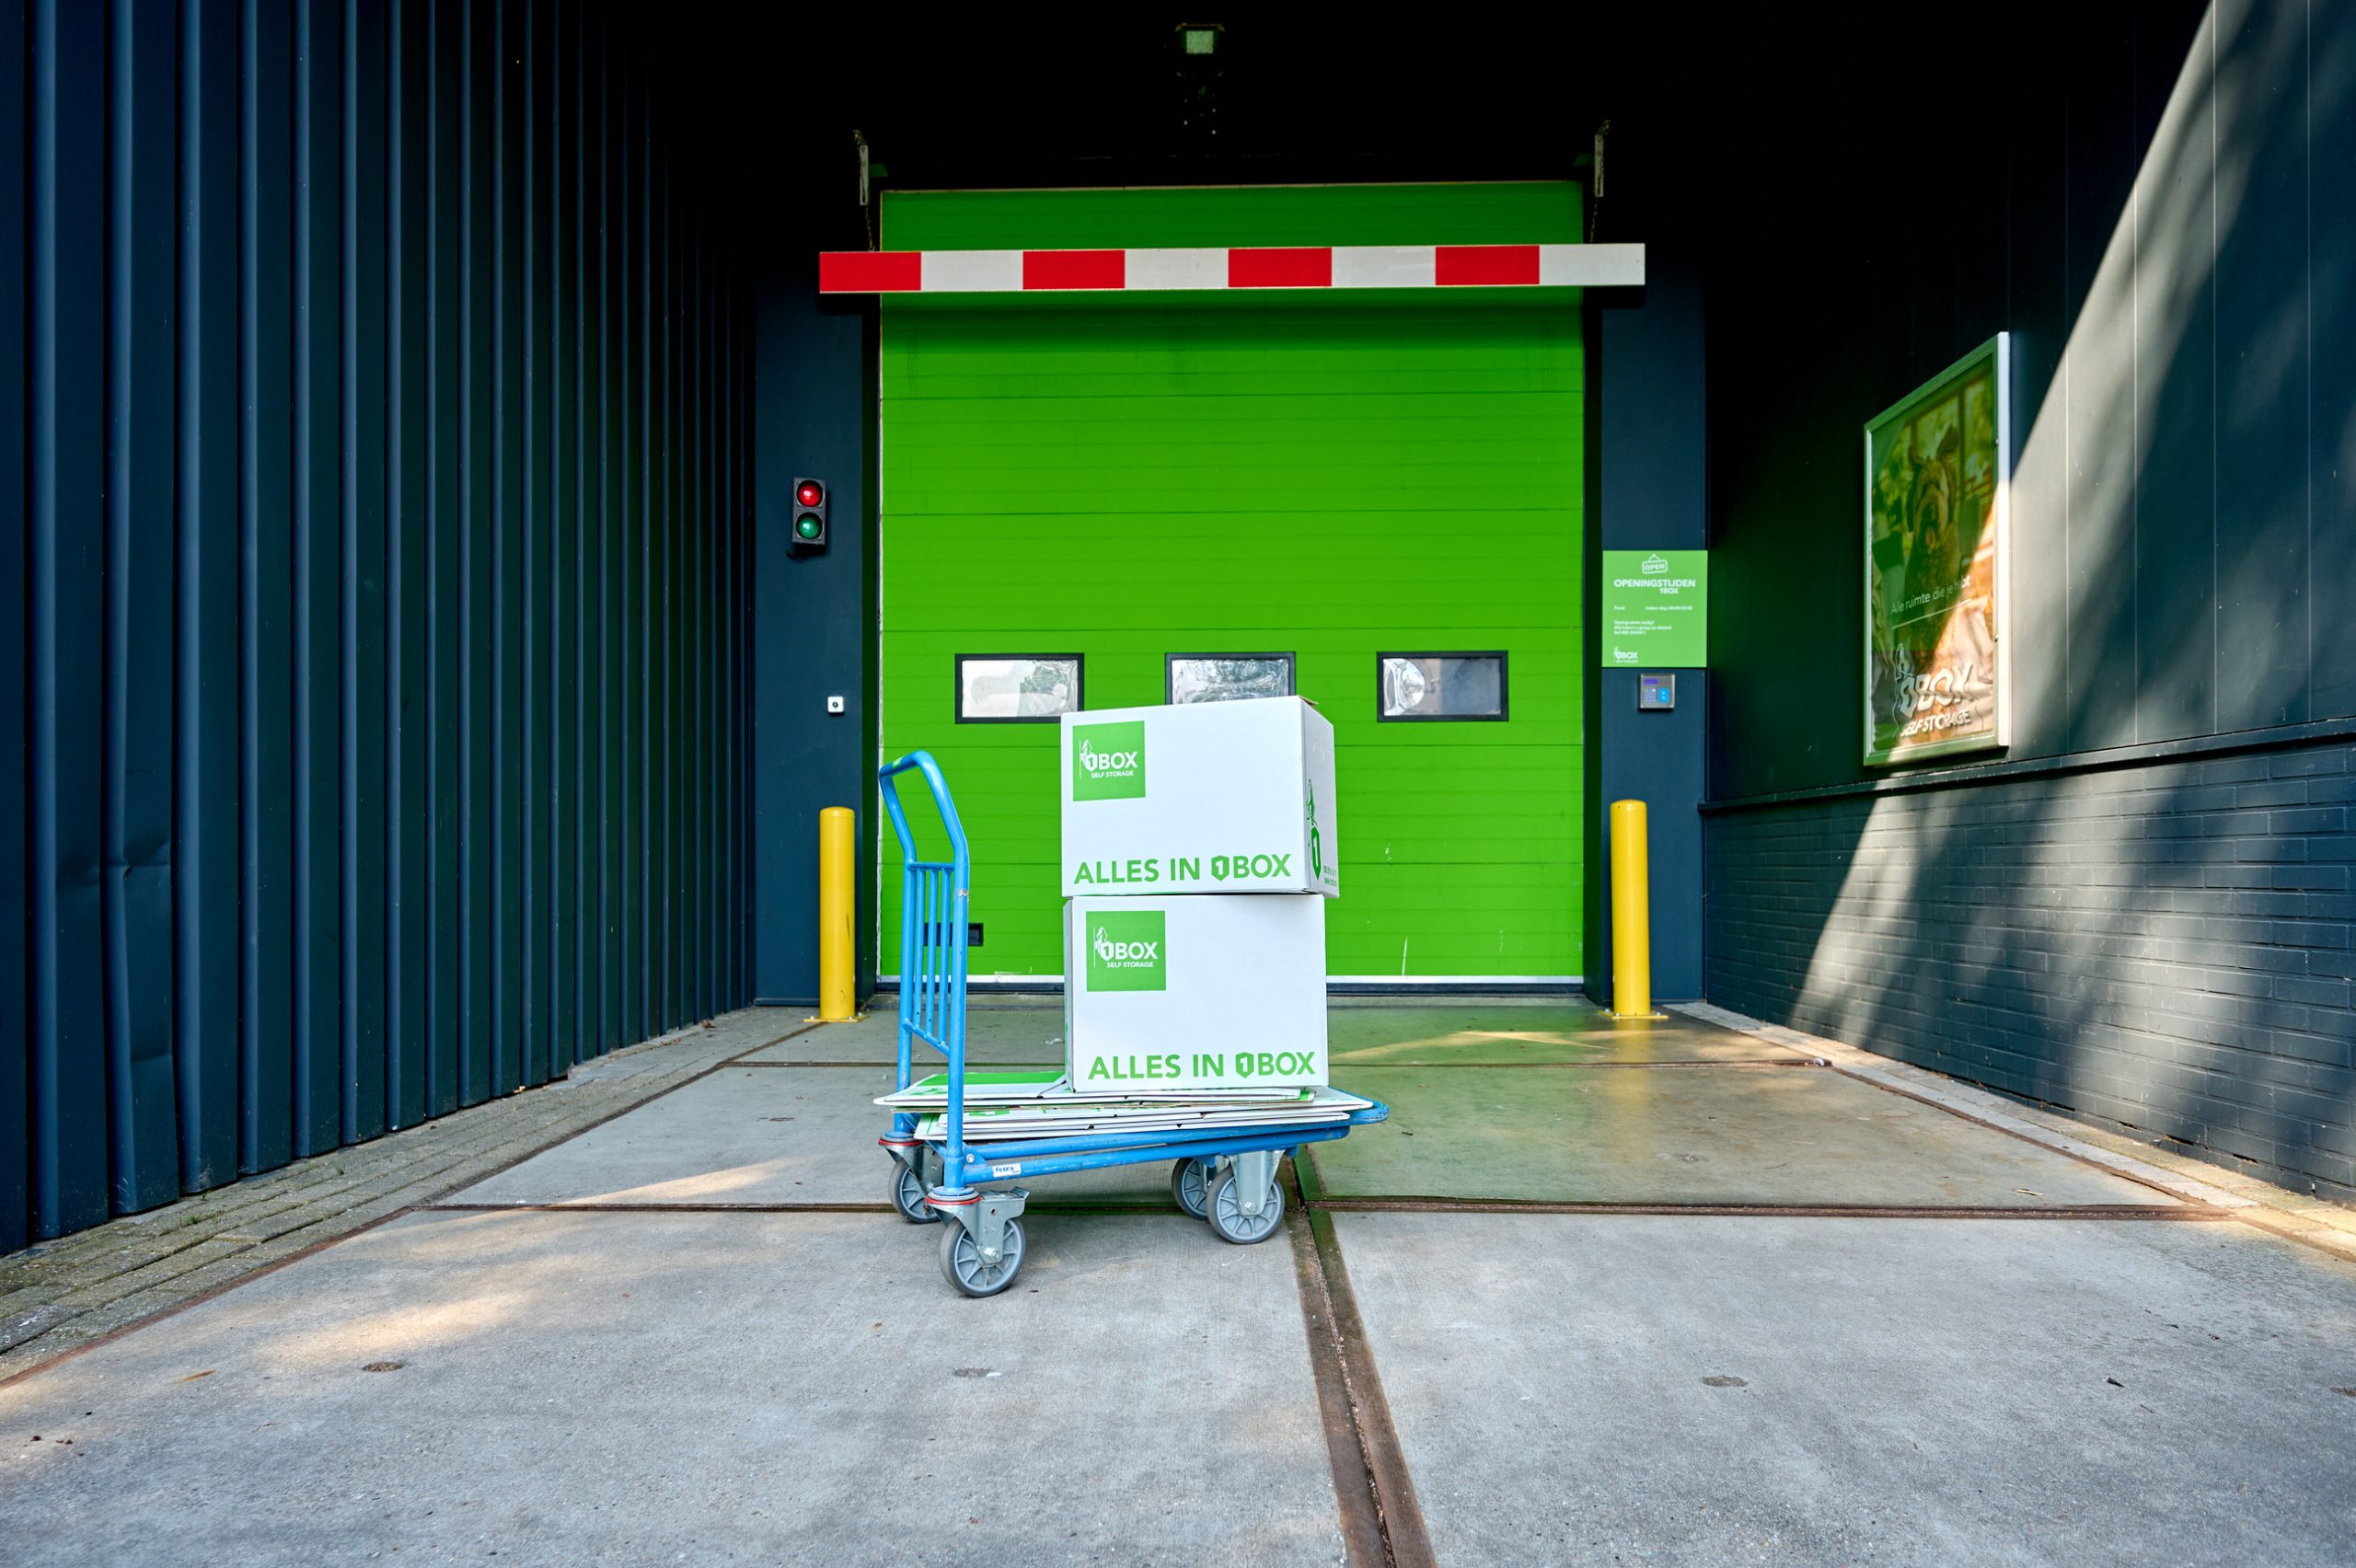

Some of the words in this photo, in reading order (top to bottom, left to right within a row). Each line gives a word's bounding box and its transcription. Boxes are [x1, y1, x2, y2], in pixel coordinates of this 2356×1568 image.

[1613, 579, 1695, 587] OPENINGSTIJDEN
[1891, 599, 1904, 615] Alle
[1906, 594, 1931, 610] ruimte
[1933, 586, 1946, 600] die
[1946, 582, 1953, 599] je
[1923, 709, 1971, 732] STORAGE
[1085, 751, 1138, 773] 1BOX
[1105, 769, 1135, 778] STORAGE
[1073, 859, 1160, 884] ALLES
[1170, 858, 1200, 881] IN
[1210, 853, 1292, 882] 1BOX
[1100, 941, 1158, 962] 1BOX
[1088, 1055, 1182, 1080] ALLES
[1193, 1054, 1224, 1078] IN
[1235, 1051, 1316, 1079] 1BOX
